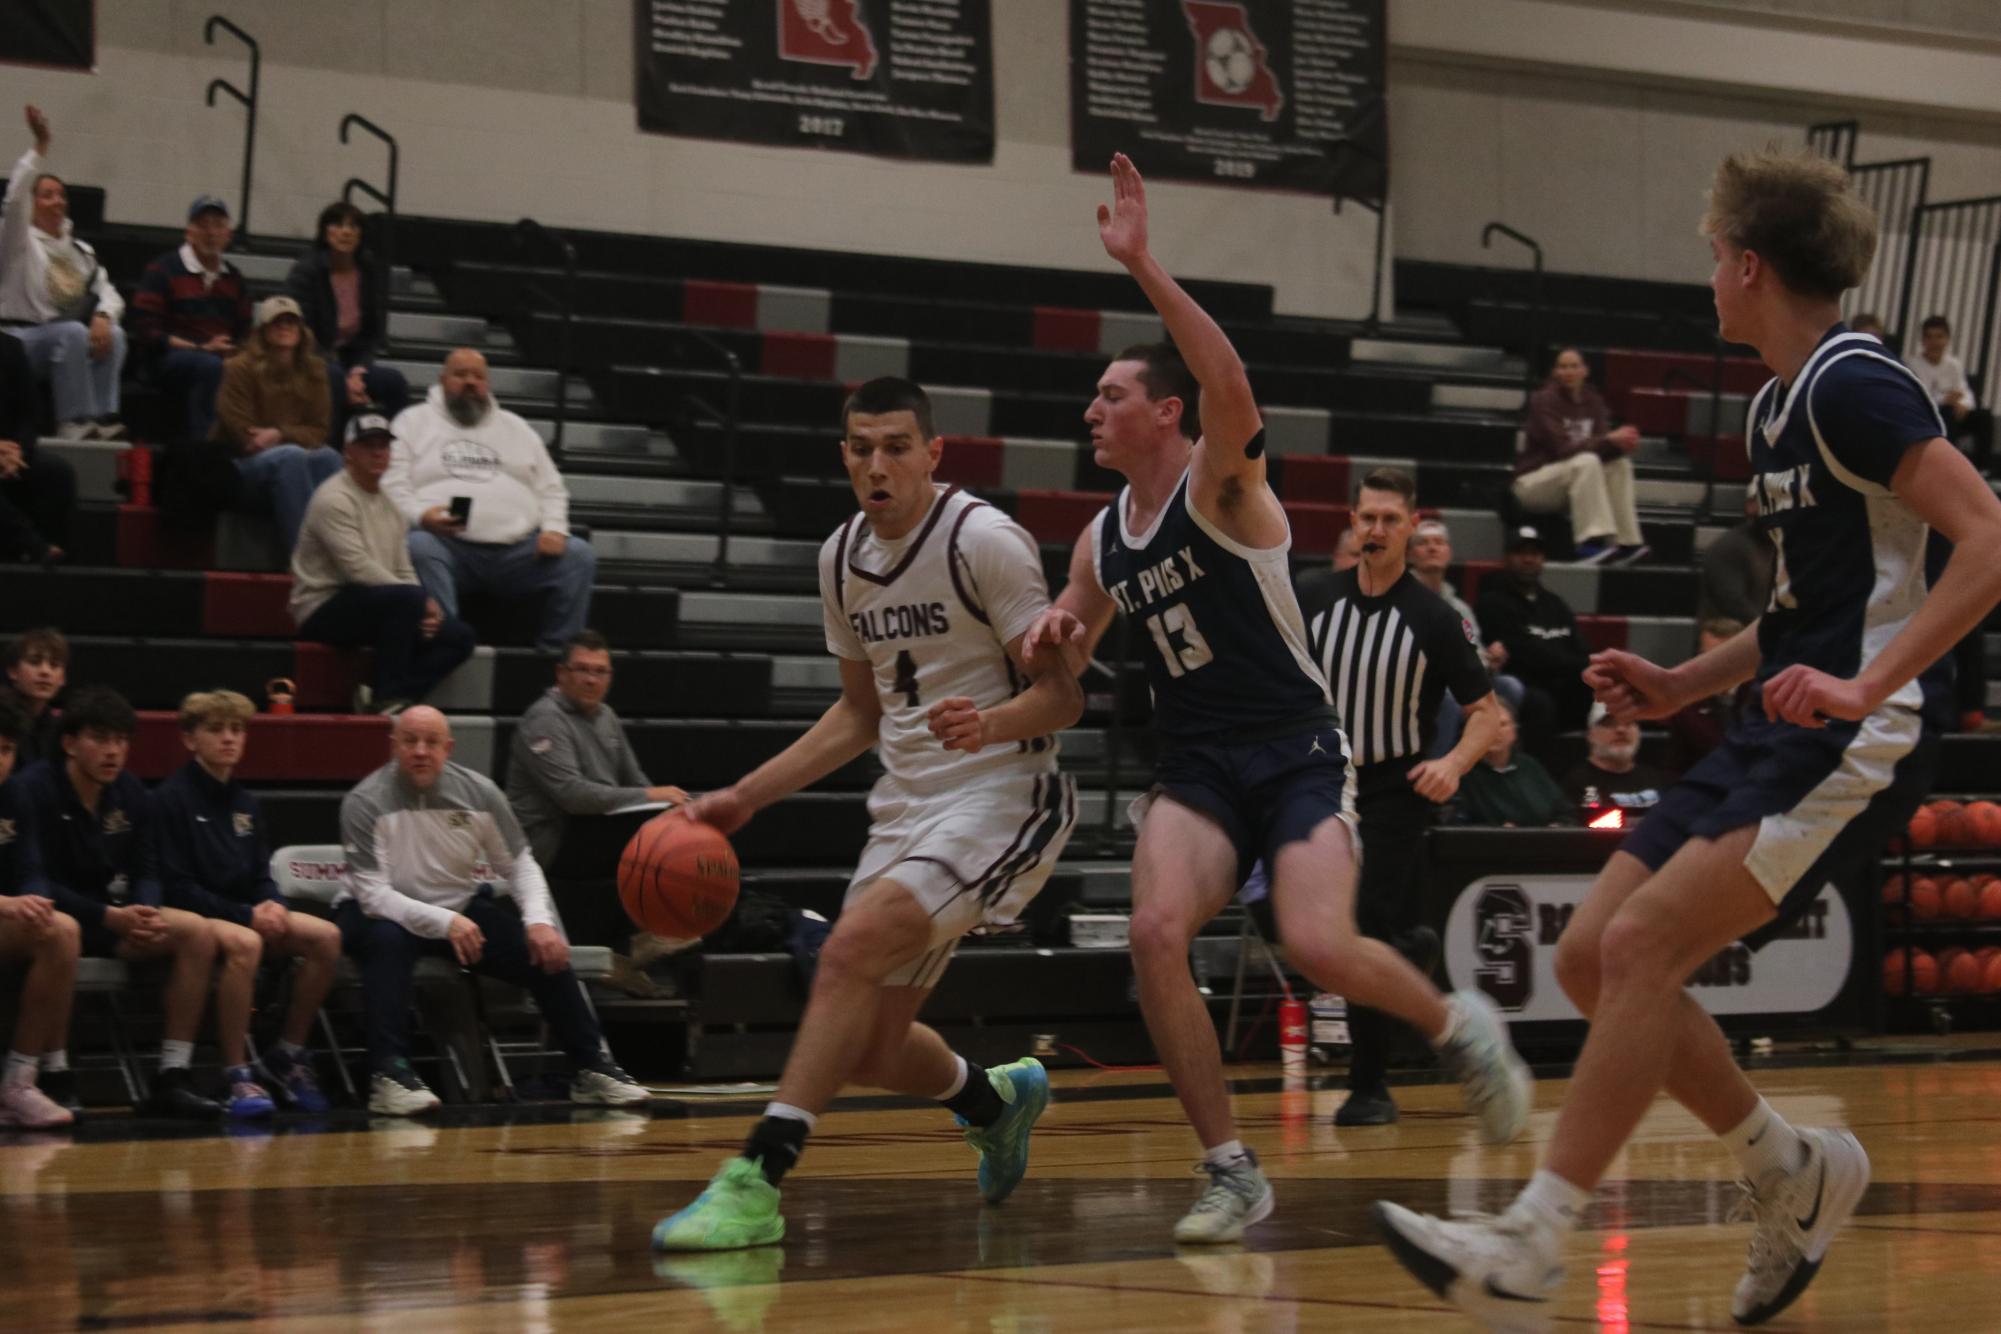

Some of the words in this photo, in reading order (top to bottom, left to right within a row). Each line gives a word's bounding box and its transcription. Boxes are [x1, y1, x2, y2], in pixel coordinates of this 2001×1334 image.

[1177, 545, 1206, 582] X
[849, 602, 949, 643] FALCONS
[1146, 602, 1215, 679] 13
[893, 650, 919, 707] 4
[289, 861, 350, 881] SUMM
